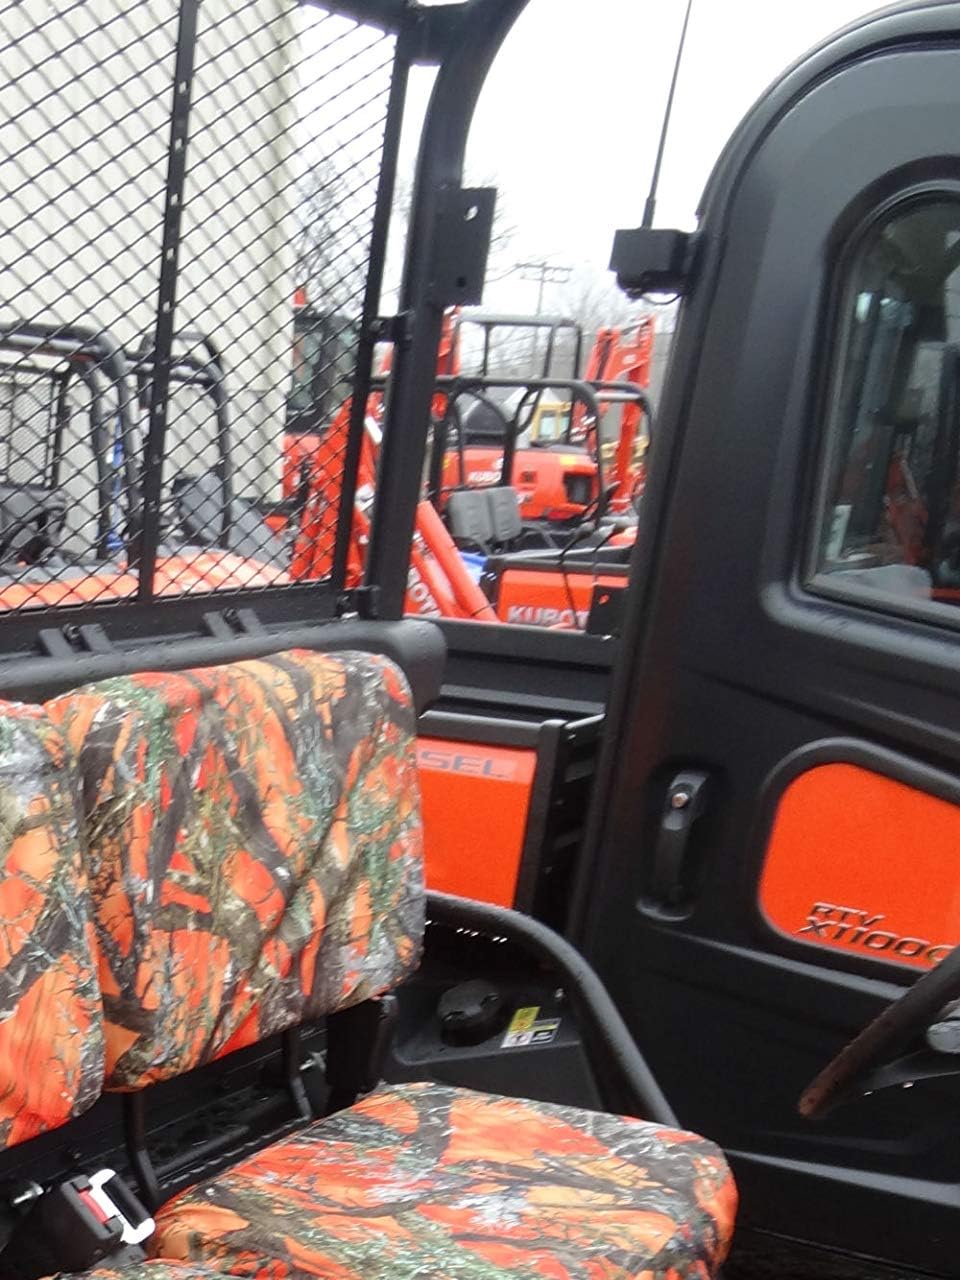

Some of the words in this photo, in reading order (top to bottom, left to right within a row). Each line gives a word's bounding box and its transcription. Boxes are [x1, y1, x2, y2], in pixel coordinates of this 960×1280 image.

[467, 470, 502, 482] KUBO
[507, 605, 590, 629] KUBOT
[420, 750, 511, 779] SEL
[809, 901, 886, 926] RTV
